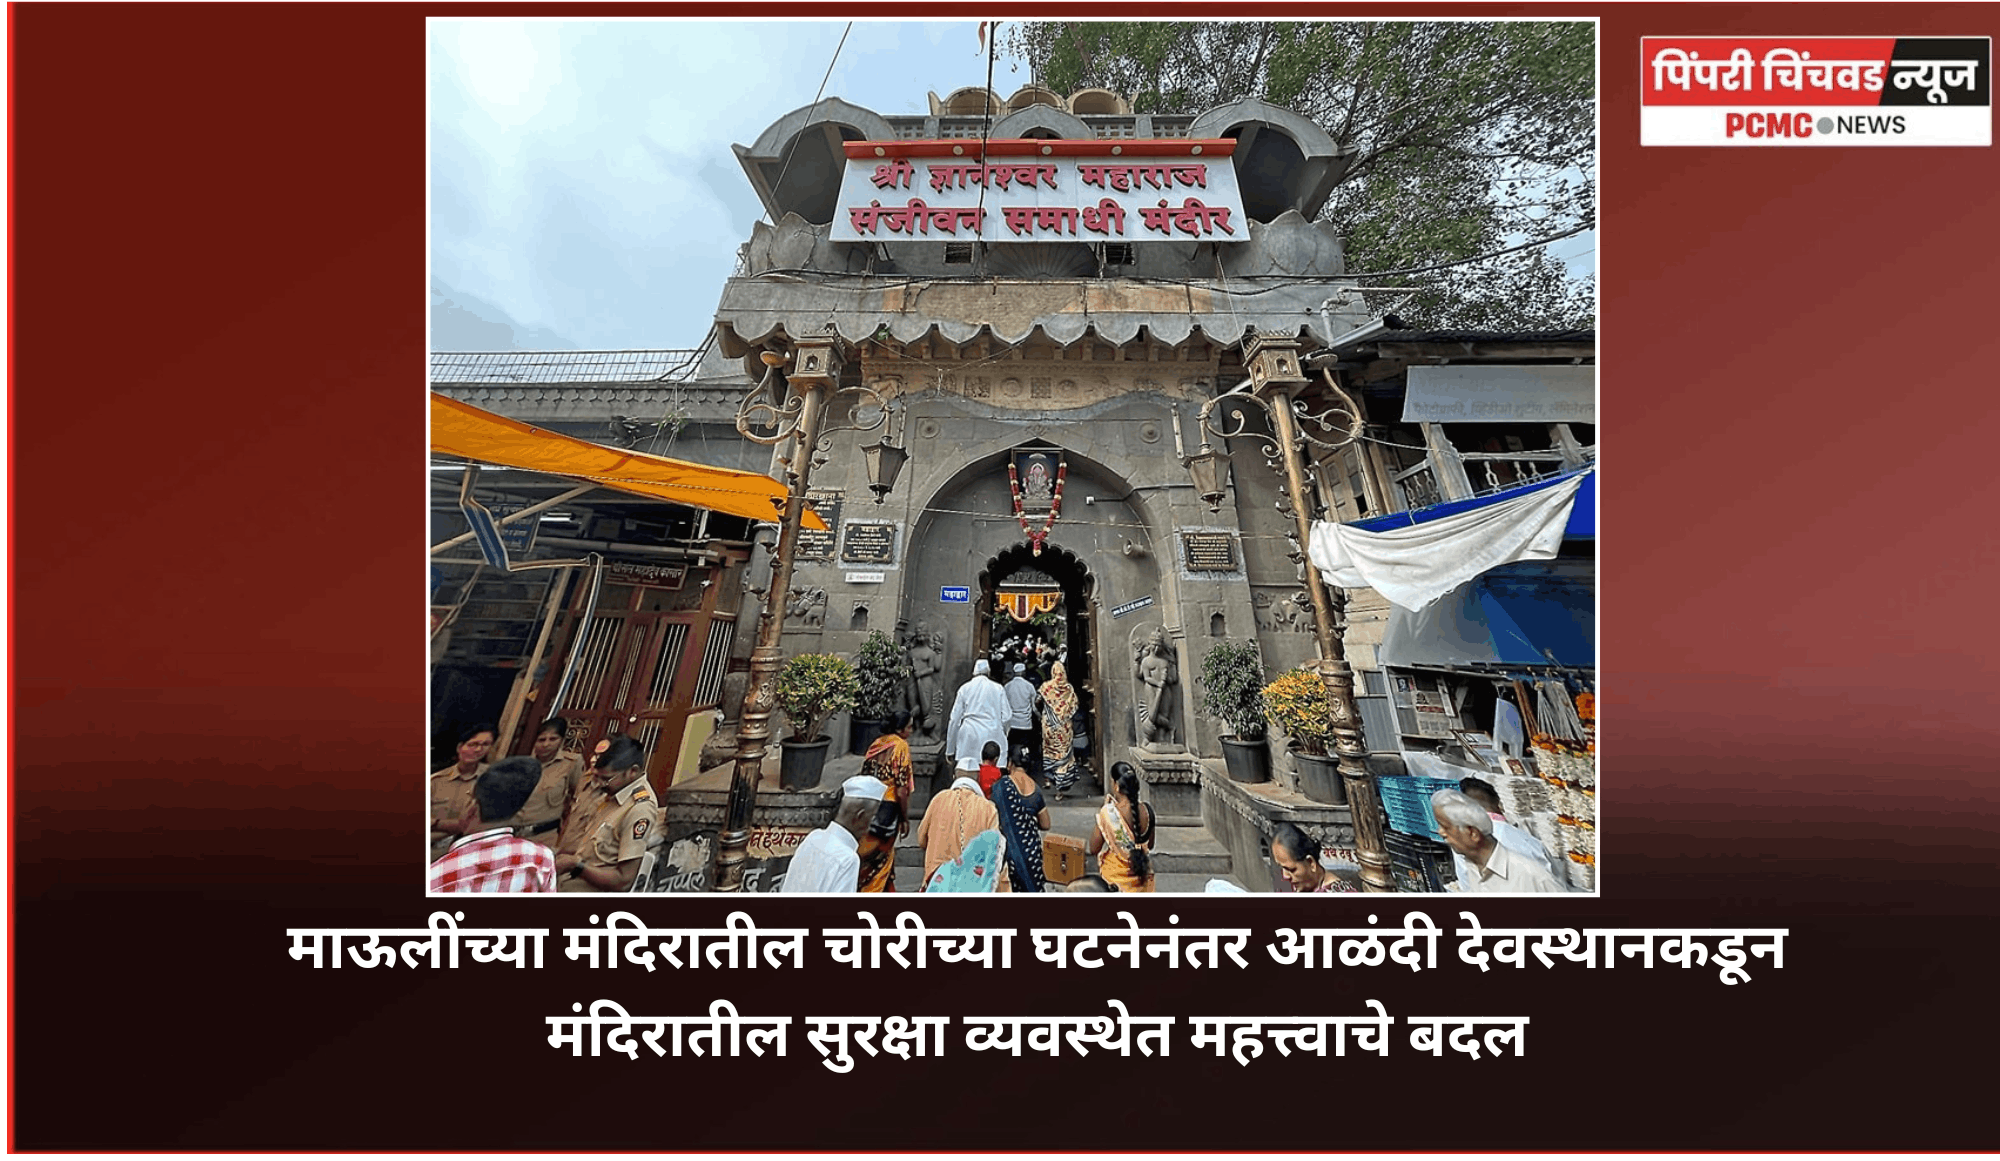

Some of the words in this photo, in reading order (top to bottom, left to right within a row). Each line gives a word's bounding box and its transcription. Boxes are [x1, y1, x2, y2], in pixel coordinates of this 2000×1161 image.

[871, 157, 914, 189] श्री
[1078, 164, 1207, 193] महाराज
[849, 198, 987, 236] संजीवन
[1002, 198, 1125, 235] समाधी
[1139, 198, 1236, 237] मंदीर
